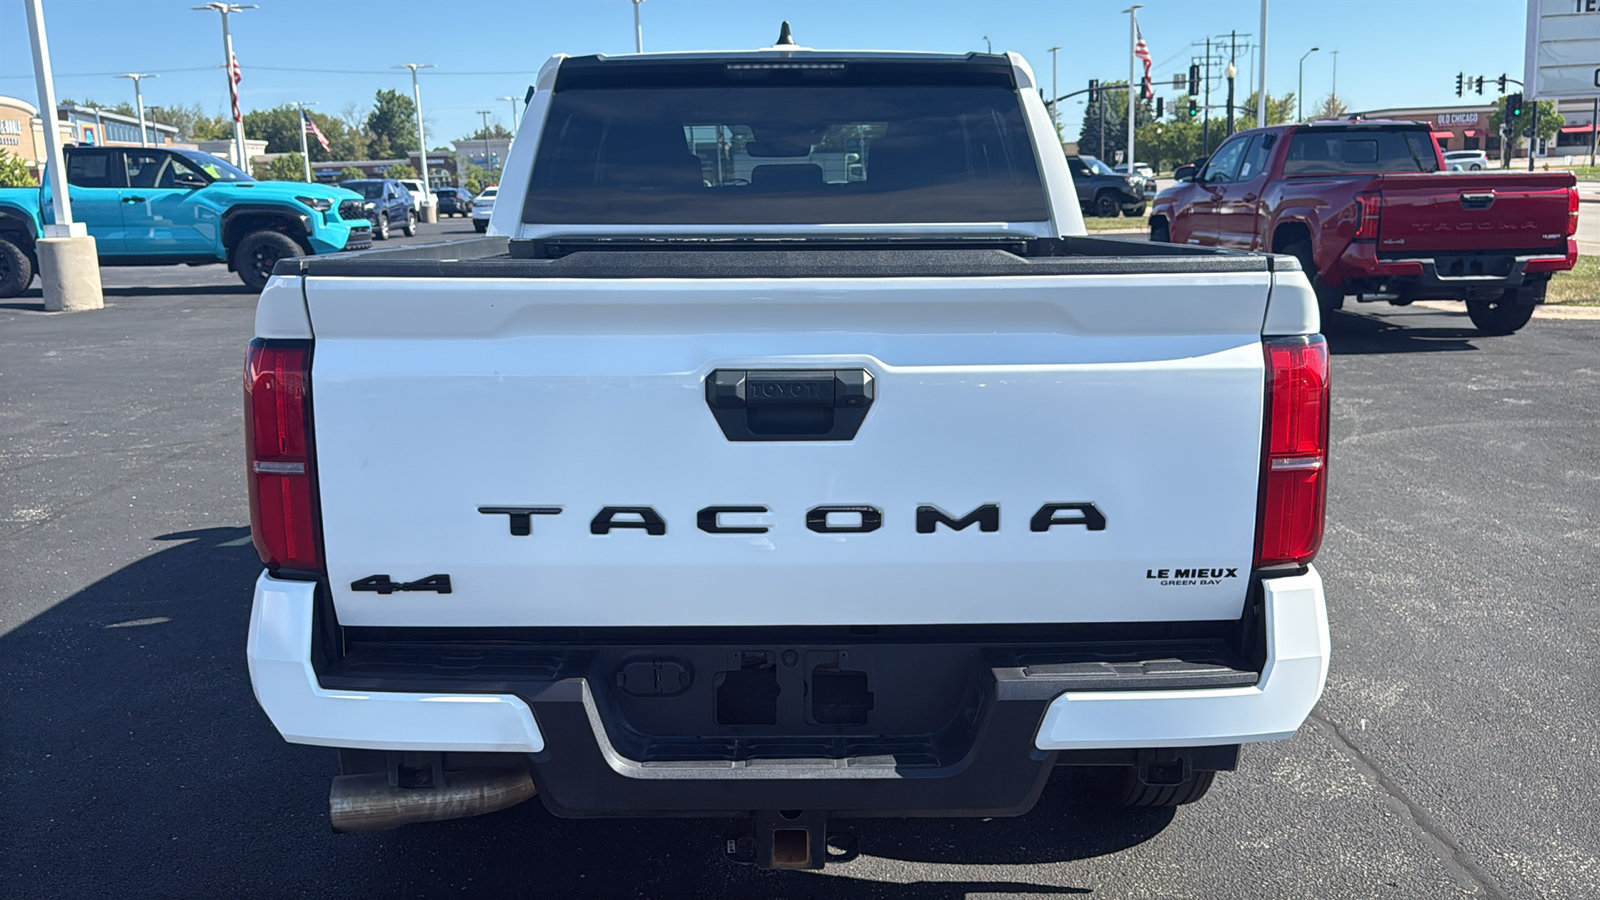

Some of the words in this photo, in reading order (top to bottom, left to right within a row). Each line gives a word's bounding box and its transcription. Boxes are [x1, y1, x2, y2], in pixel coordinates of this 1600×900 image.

[1437, 114, 1450, 124] OLD
[1451, 112, 1478, 123] CHICAGO
[1411, 221, 1537, 231] TACOMA
[750, 383, 830, 398] TOYOTA
[477, 501, 1108, 536] TACOMA
[1147, 569, 1170, 579] LE
[1175, 568, 1238, 578] MIEUX
[351, 573, 452, 594] 4x4
